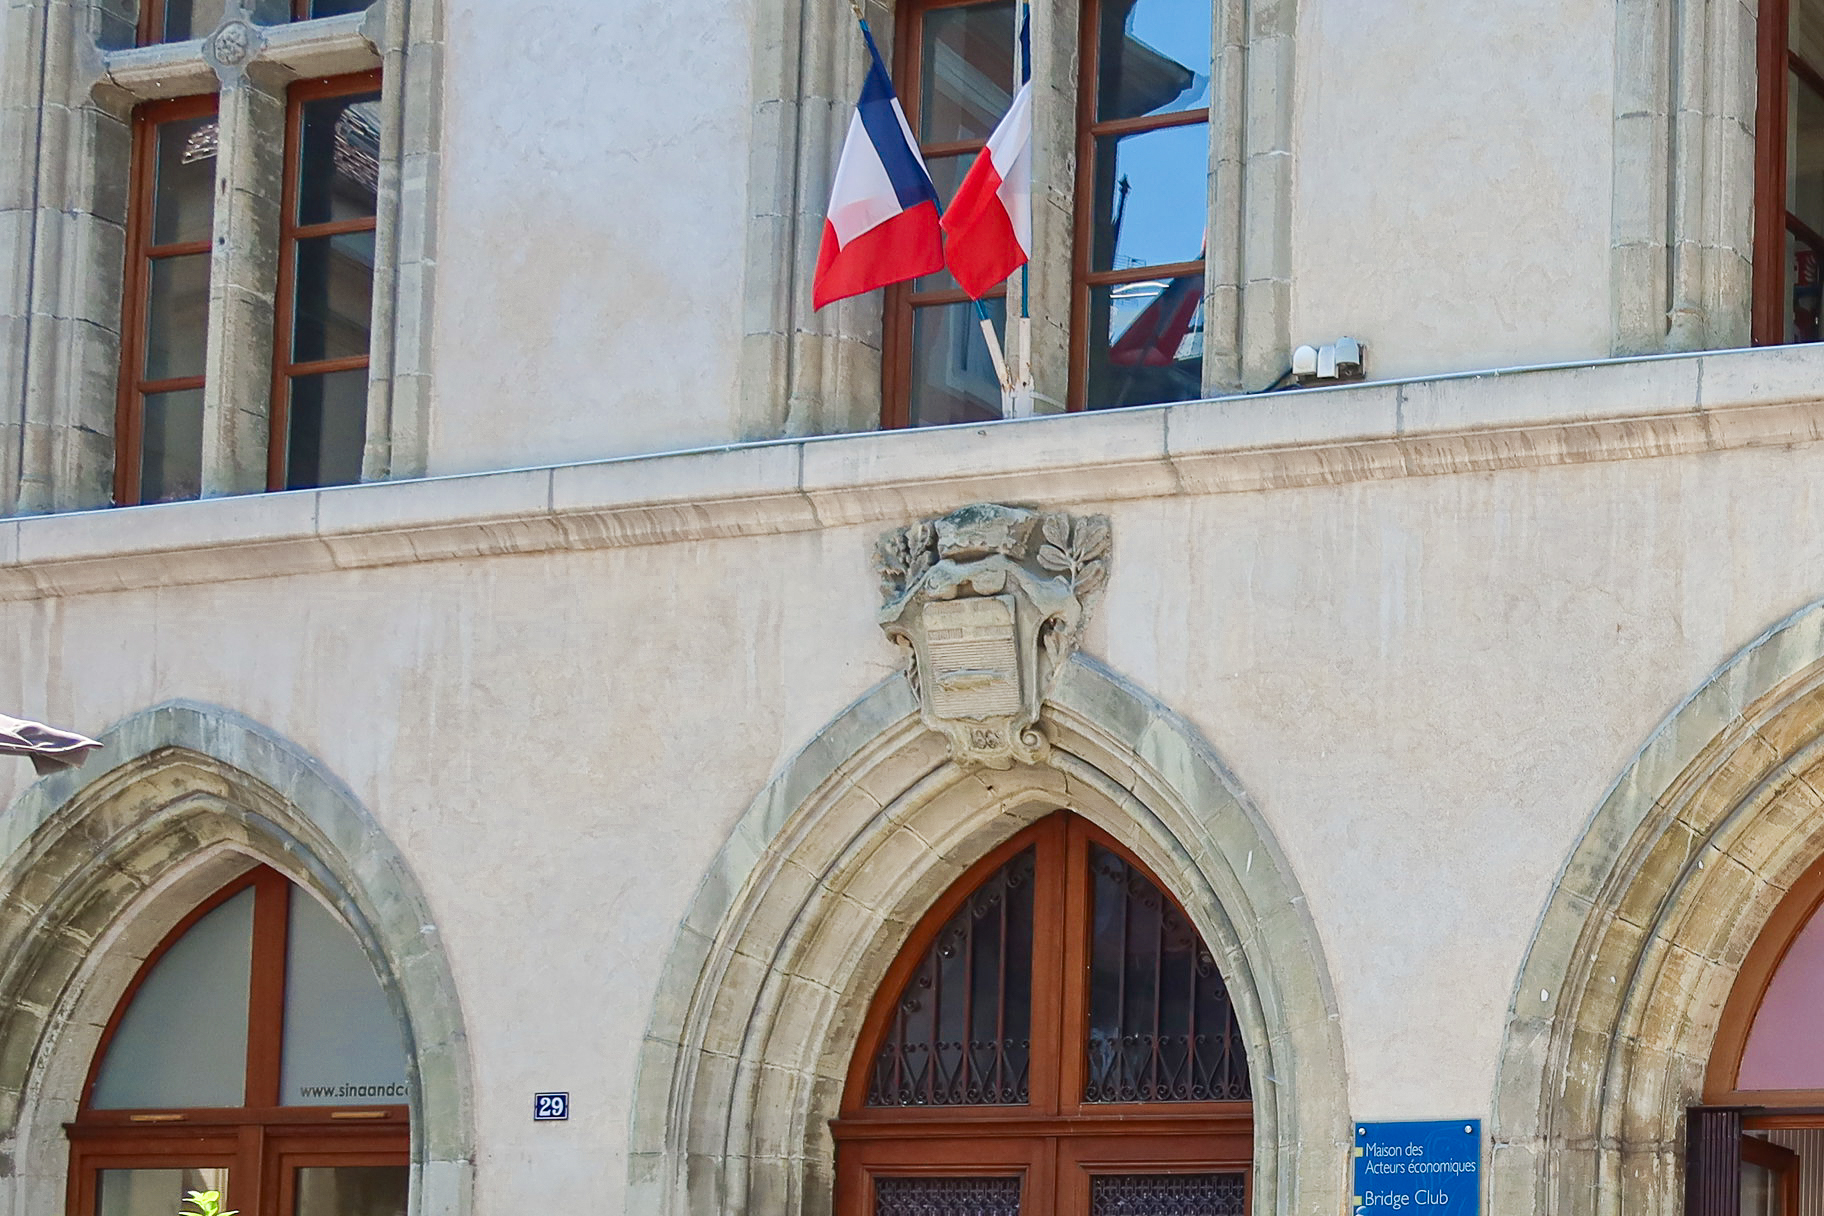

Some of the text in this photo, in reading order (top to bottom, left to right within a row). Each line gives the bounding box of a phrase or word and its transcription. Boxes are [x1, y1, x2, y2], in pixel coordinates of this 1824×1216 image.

[539, 1097, 564, 1117] 29
[1365, 1141, 1424, 1157] Maison des
[1365, 1157, 1477, 1177] Acteurs économiques
[1365, 1188, 1449, 1210] Bridge Club
